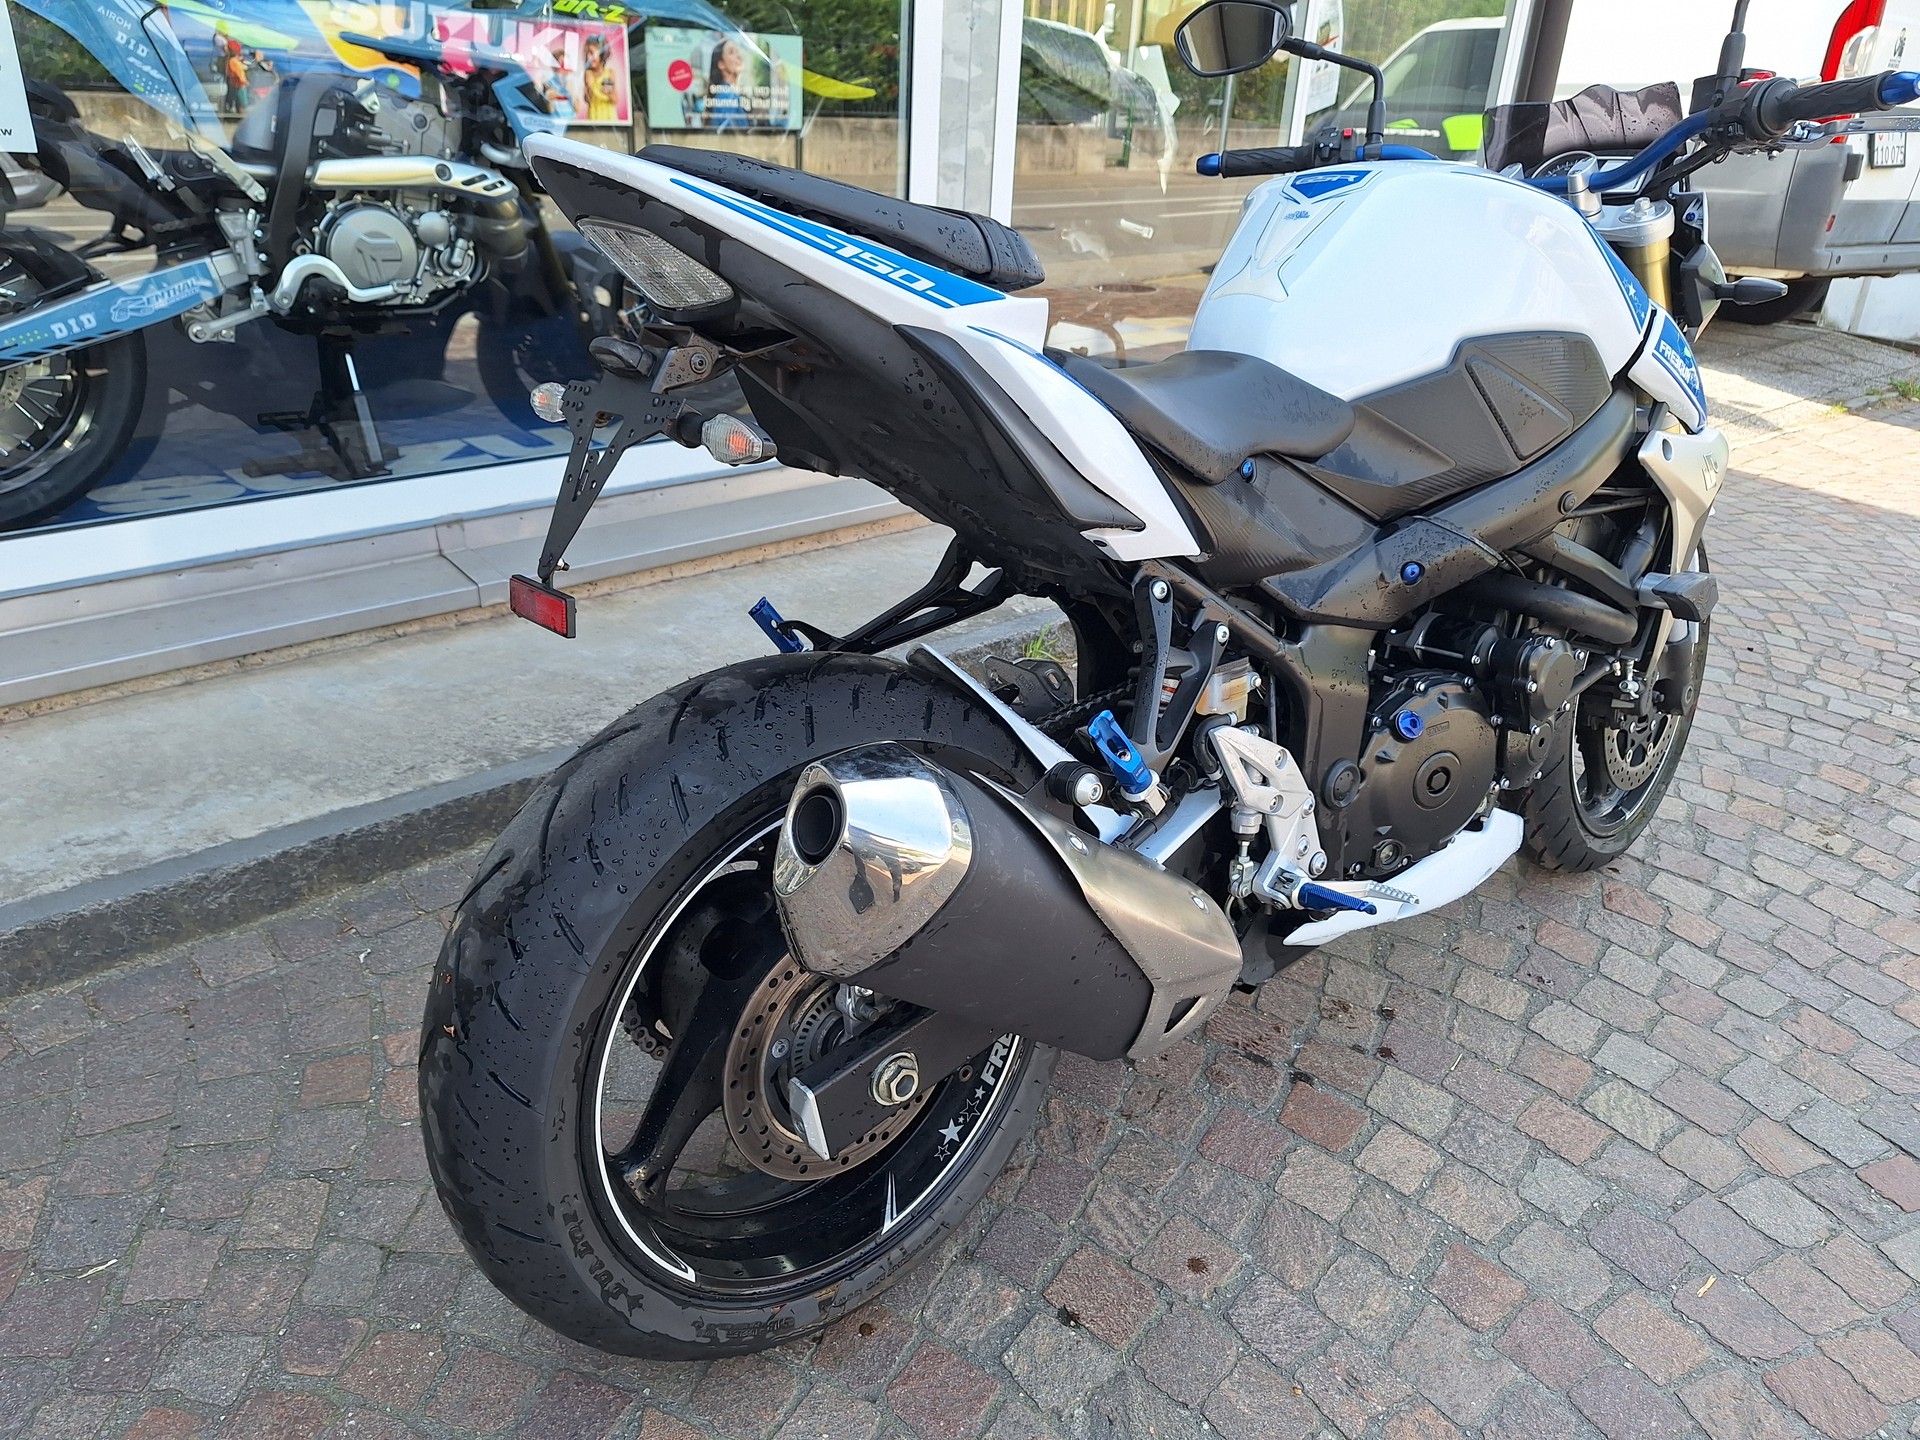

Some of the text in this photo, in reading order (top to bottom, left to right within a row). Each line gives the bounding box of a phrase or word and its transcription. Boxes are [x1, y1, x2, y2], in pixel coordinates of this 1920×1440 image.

[97, 6, 132, 30] AIROH
[329, 0, 580, 72] SUZUKI
[1875, 145, 1905, 165] 110075
[825, 233, 937, 292] 750
